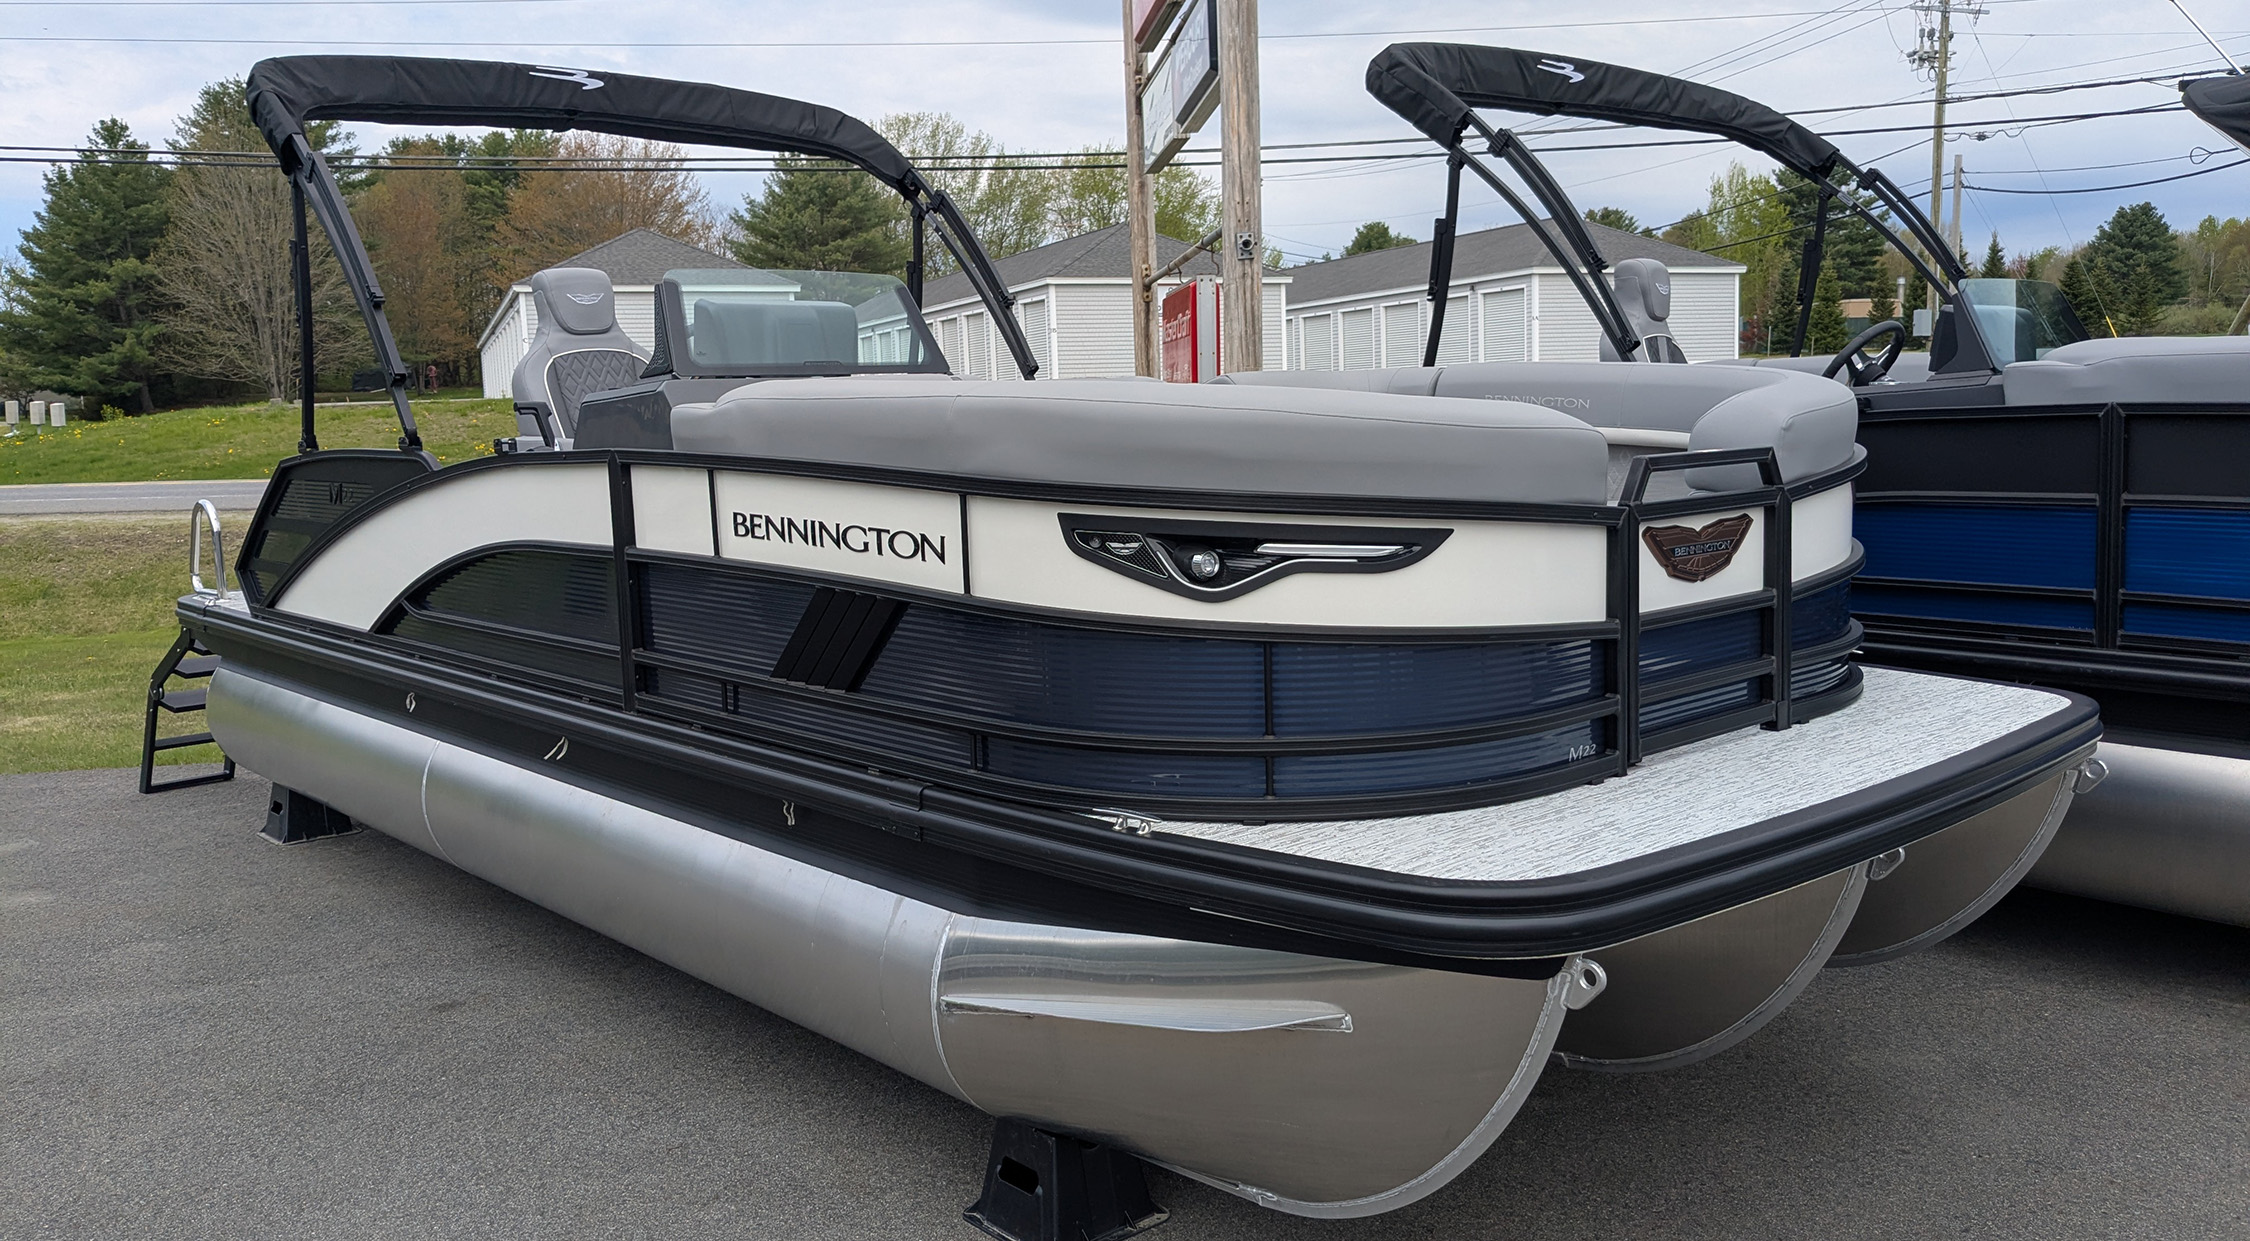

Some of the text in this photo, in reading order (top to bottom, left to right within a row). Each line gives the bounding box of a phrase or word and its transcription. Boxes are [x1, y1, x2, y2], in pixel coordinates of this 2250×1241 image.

[732, 511, 946, 565] BENNINGTON
[1674, 540, 1731, 557] BENNINGTON
[1568, 743, 1597, 762] M22
